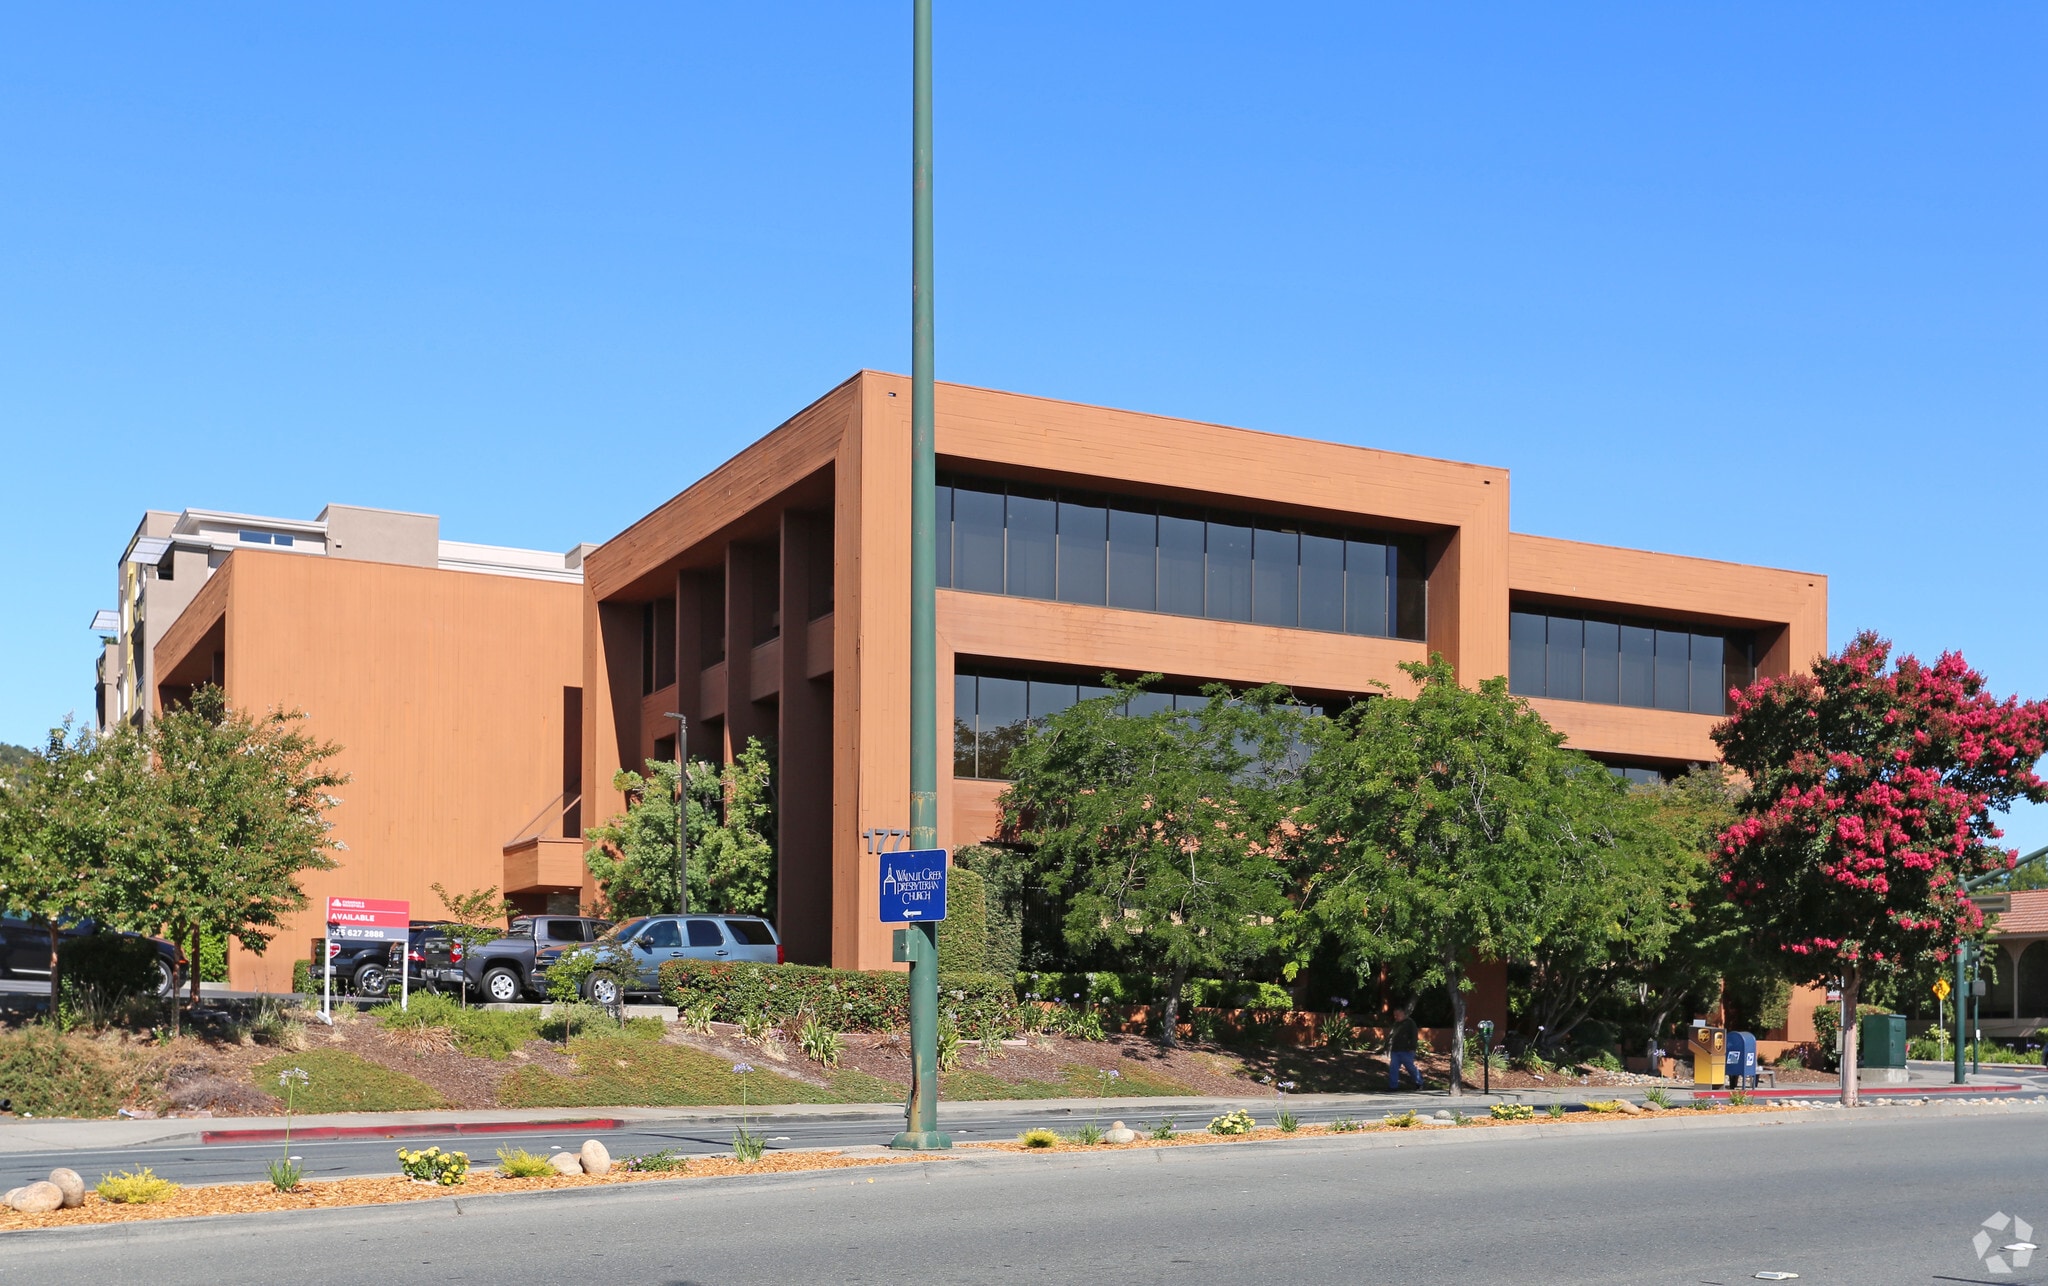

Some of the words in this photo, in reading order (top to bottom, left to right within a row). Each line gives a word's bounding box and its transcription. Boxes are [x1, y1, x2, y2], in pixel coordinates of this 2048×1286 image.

[863, 828, 910, 855] 177
[896, 869, 921, 881] WALNUT
[922, 868, 942, 880] CREEK
[897, 881, 938, 894] PRESBYTERIAN
[902, 892, 931, 904] CHURCH
[331, 913, 375, 922] AVAILABLE
[347, 929, 362, 937] 627
